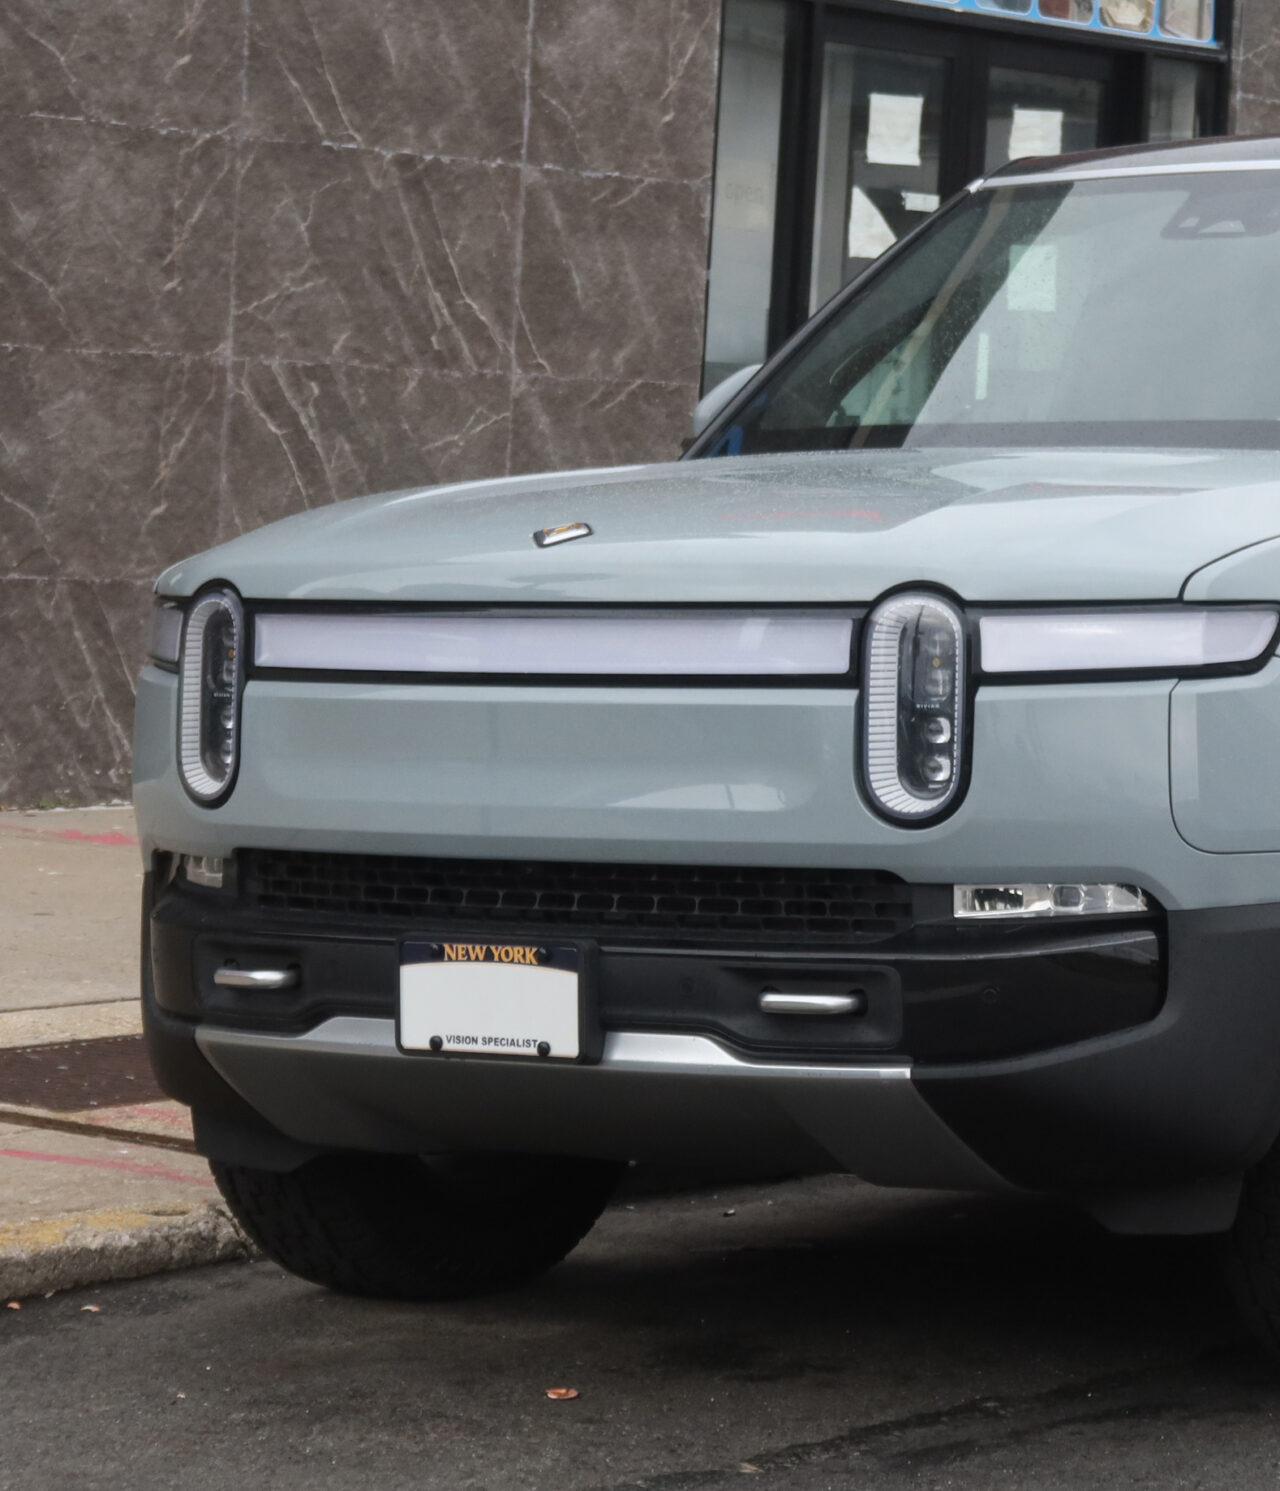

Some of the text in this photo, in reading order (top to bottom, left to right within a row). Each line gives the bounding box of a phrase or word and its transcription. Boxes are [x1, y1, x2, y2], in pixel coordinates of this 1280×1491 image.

[443, 944, 538, 965] NEW YORK
[445, 1035, 538, 1049] VISION SPECIALIST
